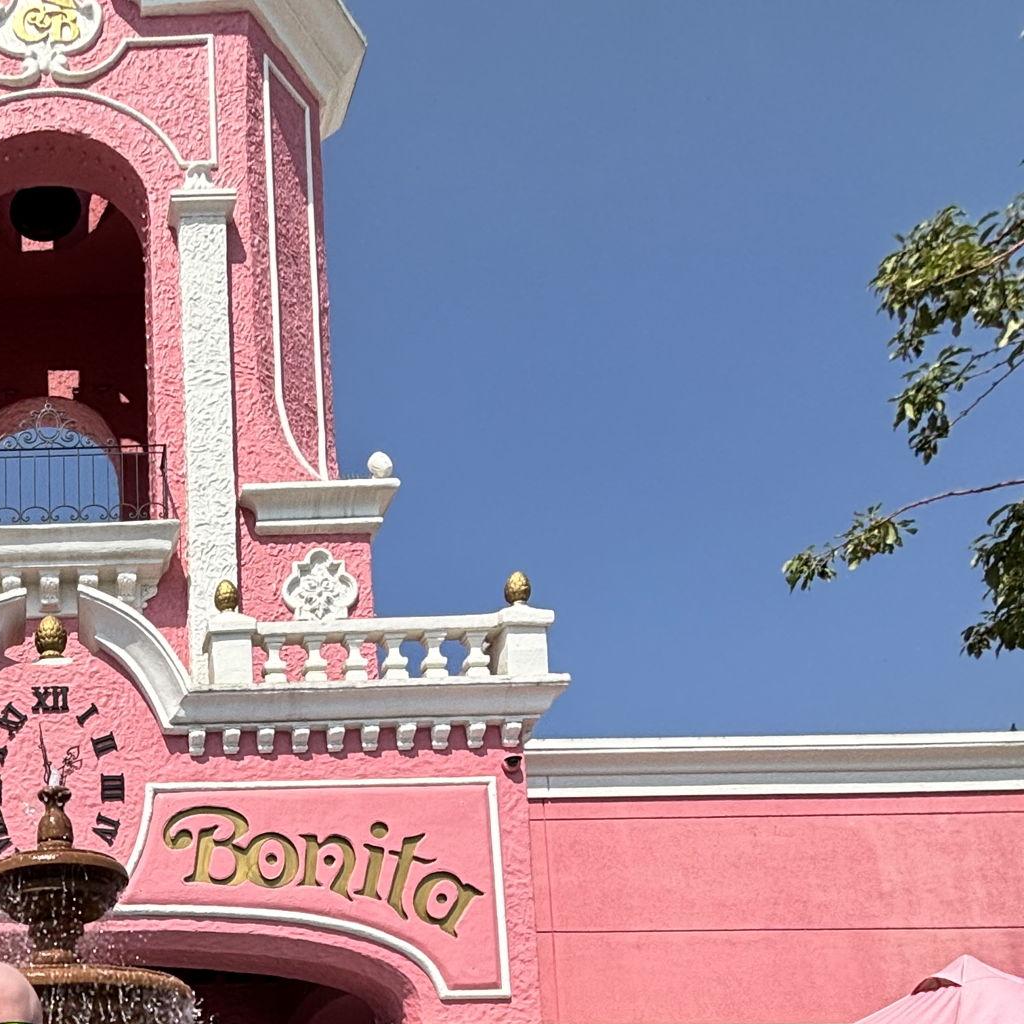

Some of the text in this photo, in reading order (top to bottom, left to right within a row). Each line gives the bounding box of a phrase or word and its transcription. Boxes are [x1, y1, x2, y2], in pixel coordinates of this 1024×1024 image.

[31, 686, 70, 714] XII
[76, 703, 99, 727] I
[91, 731, 118, 760] II
[100, 773, 125, 803] III
[91, 812, 121, 847] IV
[163, 805, 484, 938] Bonita
